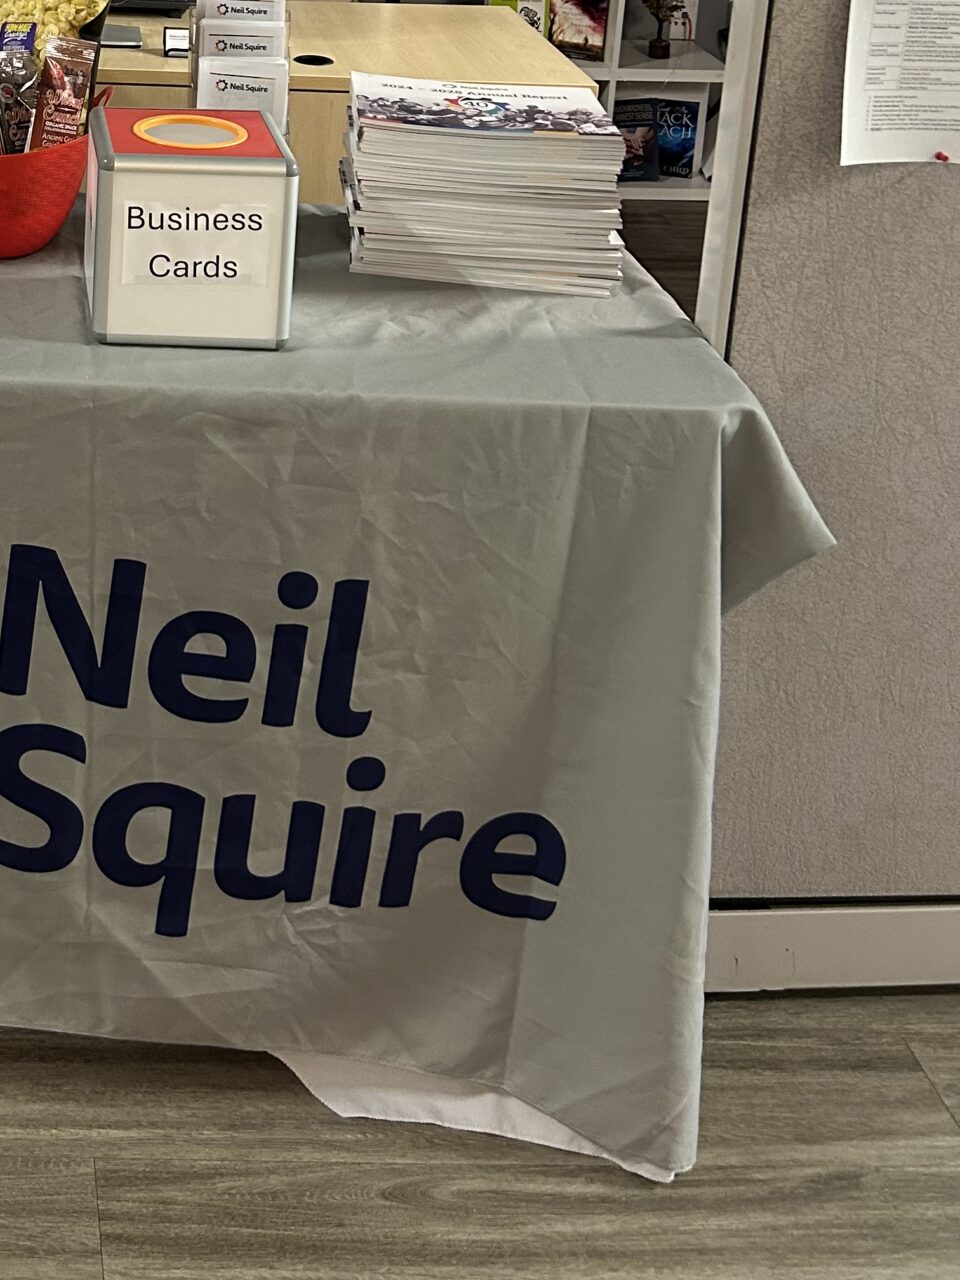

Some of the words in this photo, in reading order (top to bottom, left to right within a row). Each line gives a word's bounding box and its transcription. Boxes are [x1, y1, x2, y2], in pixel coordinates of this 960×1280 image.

[230, 6, 244, 14] Neil
[245, 7, 268, 16] Squire
[229, 42, 243, 50] Neil
[244, 43, 267, 52] Squire
[229, 82, 244, 91] Neil
[245, 84, 268, 93] Squire
[466, 91, 518, 99] Annual
[128, 206, 263, 231] Business
[149, 254, 238, 279] Cards
